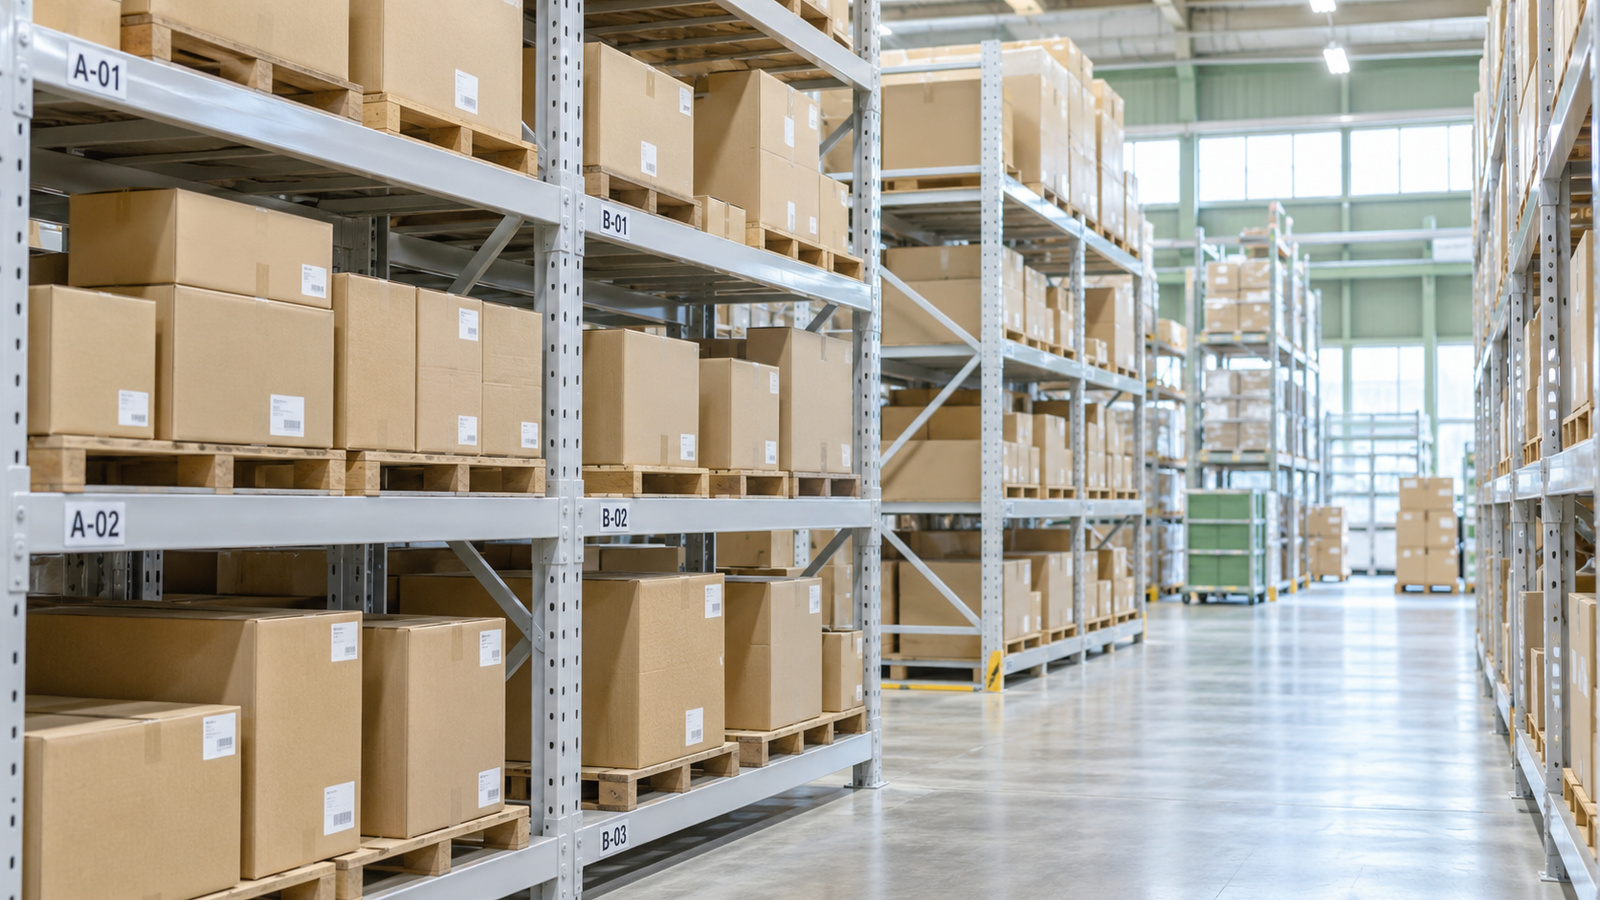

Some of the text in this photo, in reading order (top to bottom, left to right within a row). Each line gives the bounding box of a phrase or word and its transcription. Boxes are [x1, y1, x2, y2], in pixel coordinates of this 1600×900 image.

[73, 53, 119, 91] A-01
[603, 209, 628, 235] B-01
[70, 510, 120, 538] A-02
[602, 507, 628, 528] B-02
[602, 824, 627, 852] B-03
